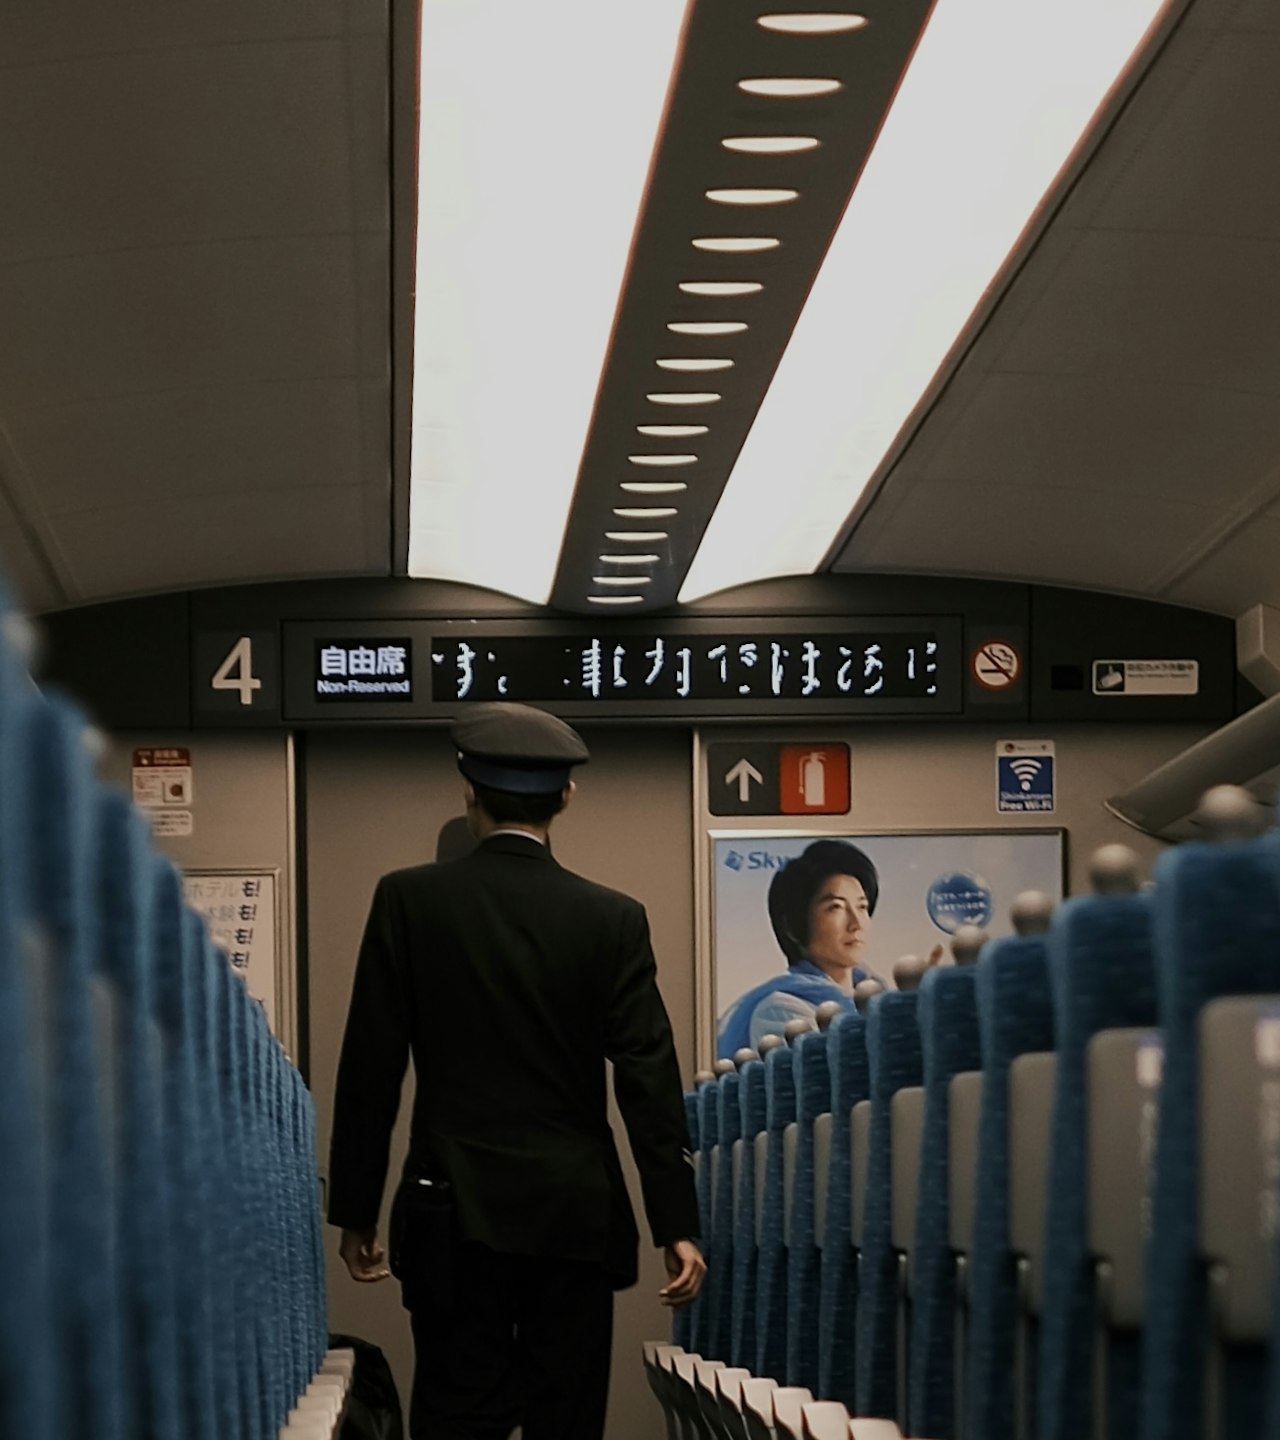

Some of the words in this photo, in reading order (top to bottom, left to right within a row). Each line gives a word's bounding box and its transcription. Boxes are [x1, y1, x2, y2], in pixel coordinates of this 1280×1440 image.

[212, 637, 262, 705] 4
[321, 646, 407, 676] 自由席
[317, 680, 410, 694] Non-Reserved
